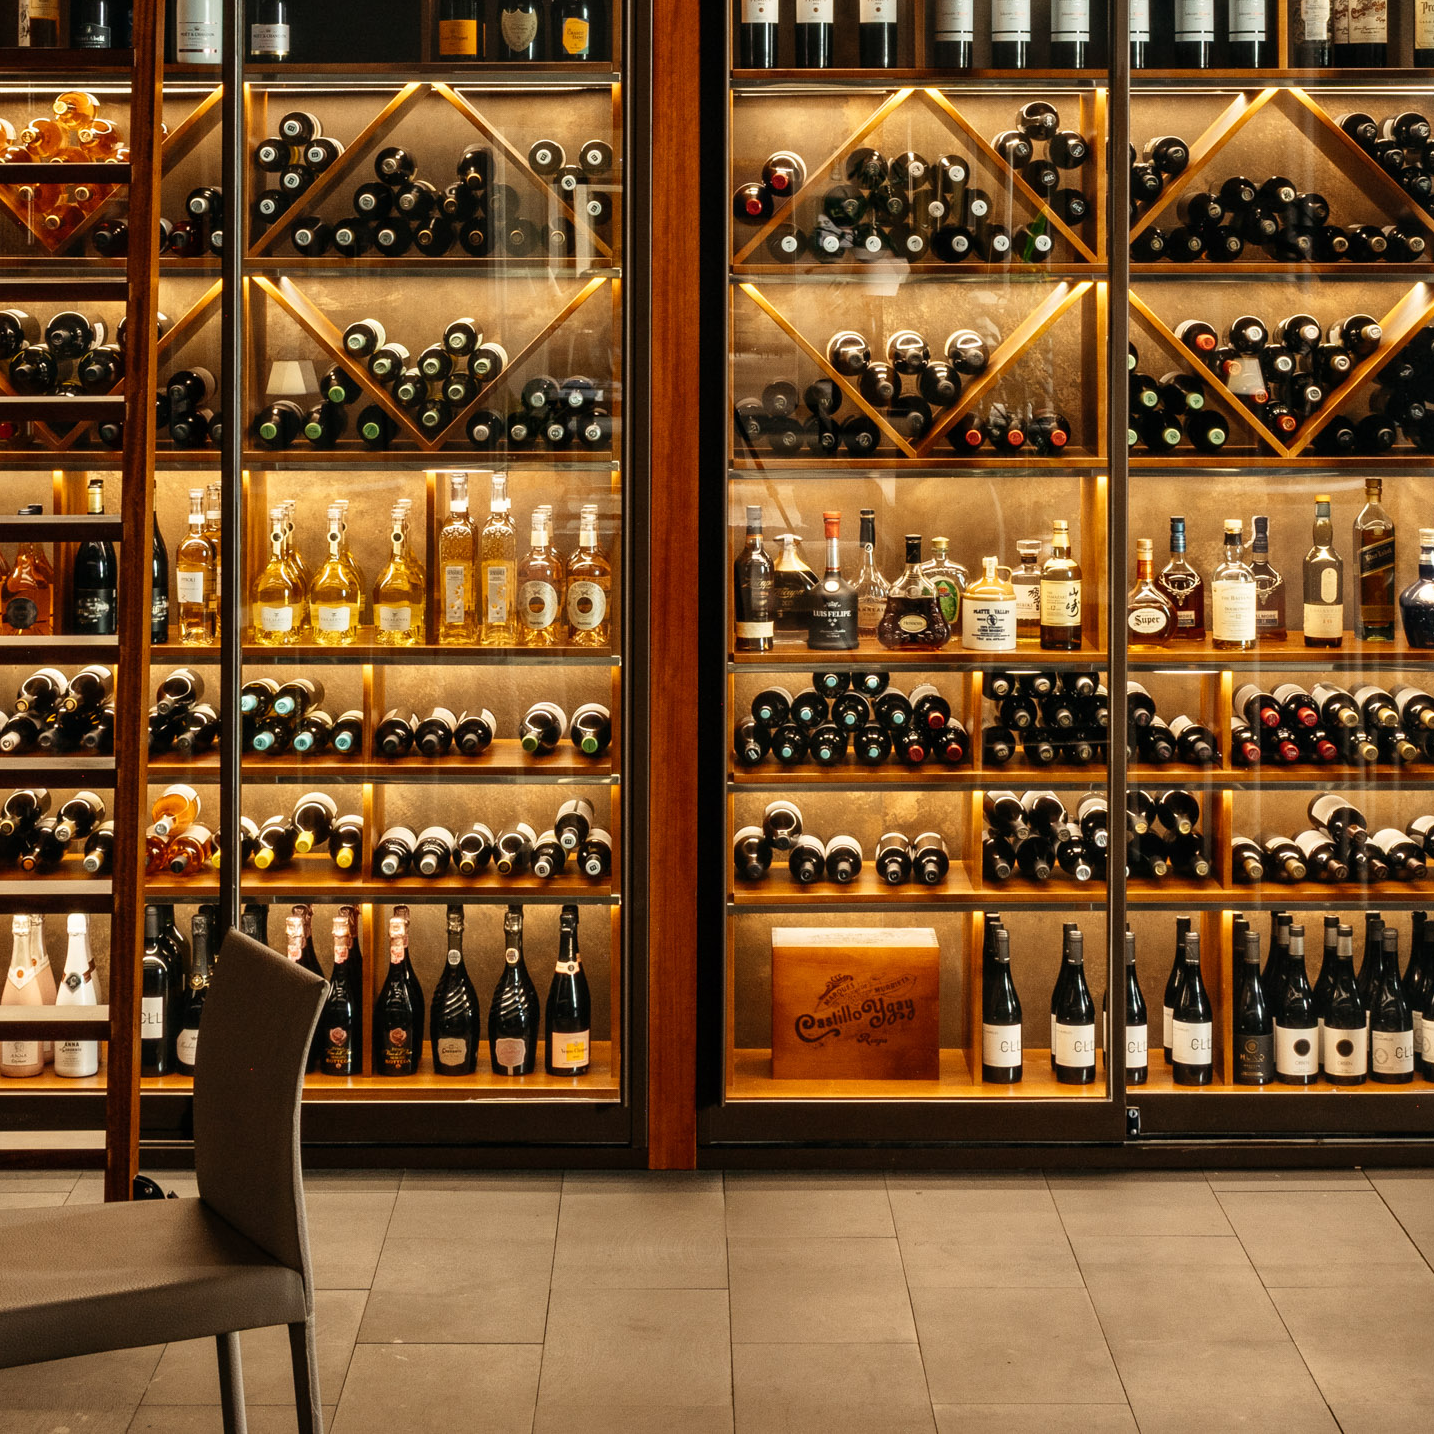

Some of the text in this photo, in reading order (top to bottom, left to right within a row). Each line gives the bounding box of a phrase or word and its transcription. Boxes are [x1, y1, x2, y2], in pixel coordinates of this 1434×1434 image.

[1133, 615, 1160, 628] Super
[874, 976, 910, 993] MURRIETA
[861, 997, 915, 1029] Ygay
